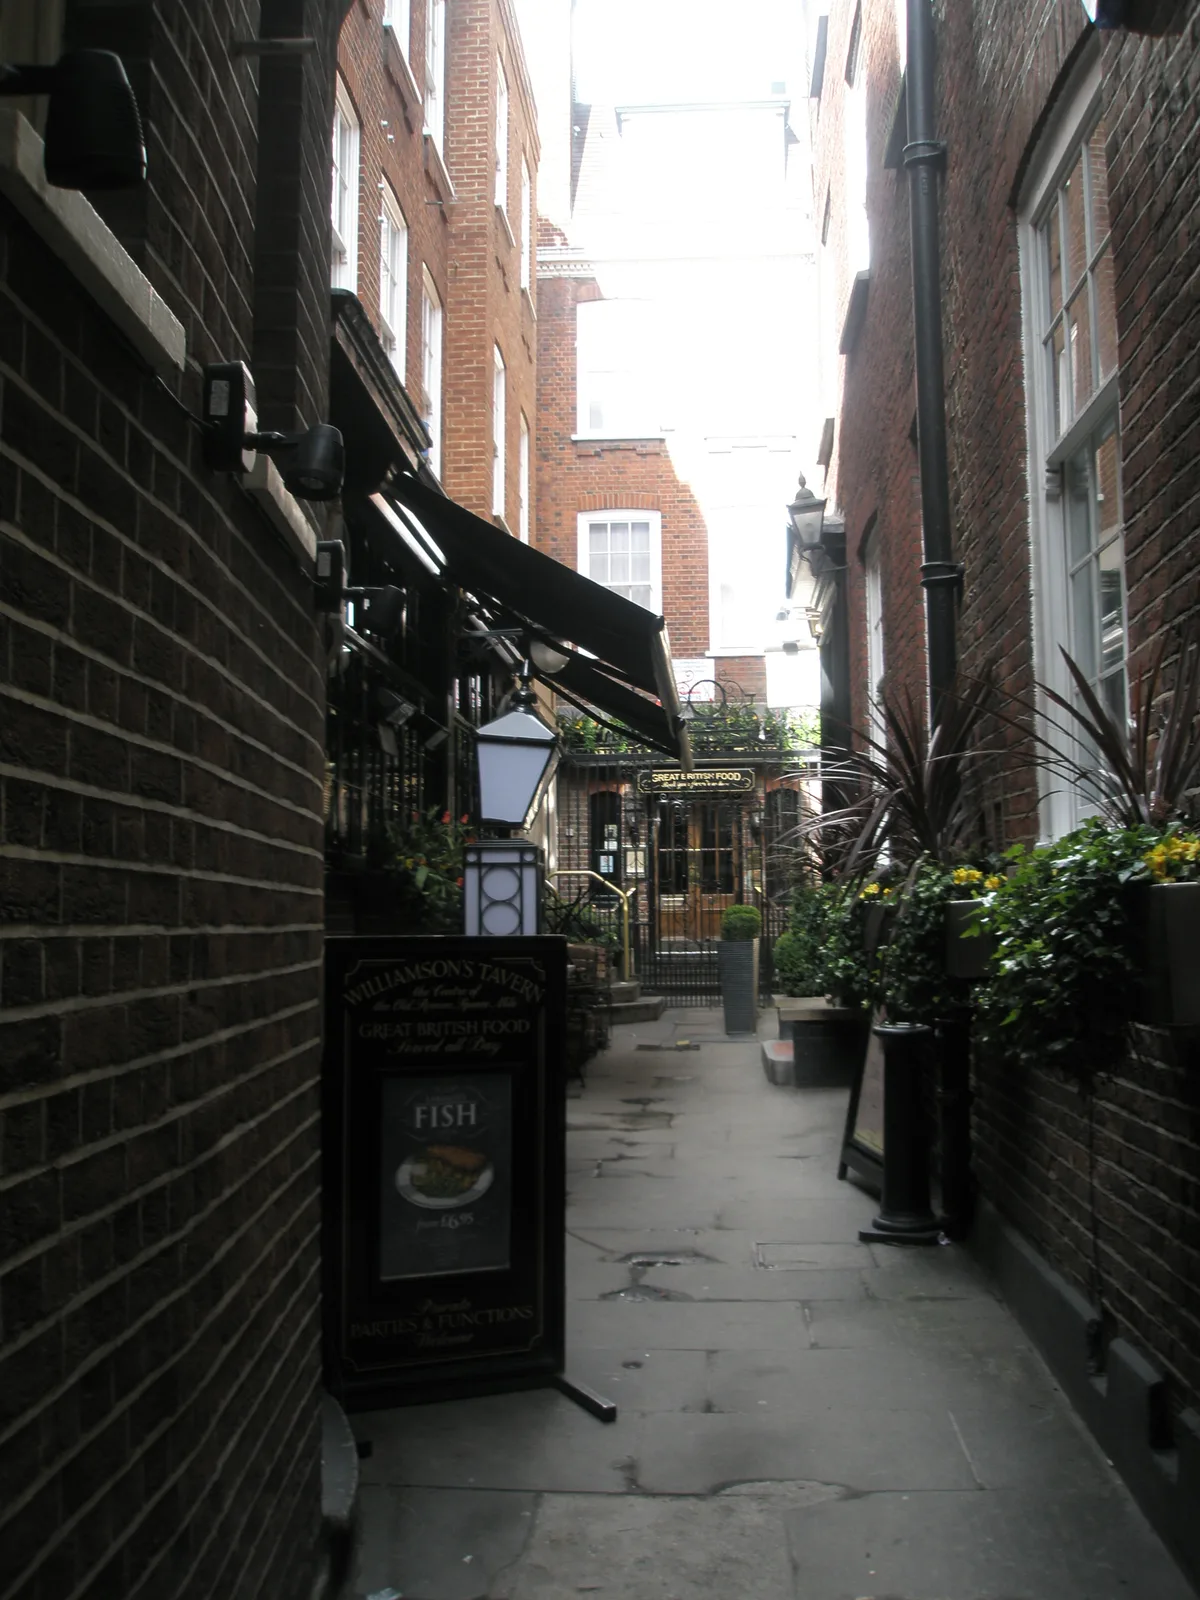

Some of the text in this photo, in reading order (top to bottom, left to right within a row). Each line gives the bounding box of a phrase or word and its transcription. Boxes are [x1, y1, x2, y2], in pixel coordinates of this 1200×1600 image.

[716, 771, 741, 781] FOOD
[342, 959, 546, 1006] WILLIAMSON'S TAVERN
[358, 1017, 532, 1040] GREAT BRITISH FOOD
[414, 1103, 477, 1129] FISH
[350, 1318, 417, 1339] PARTIES
[438, 1304, 535, 1329] FUNCTIONS
